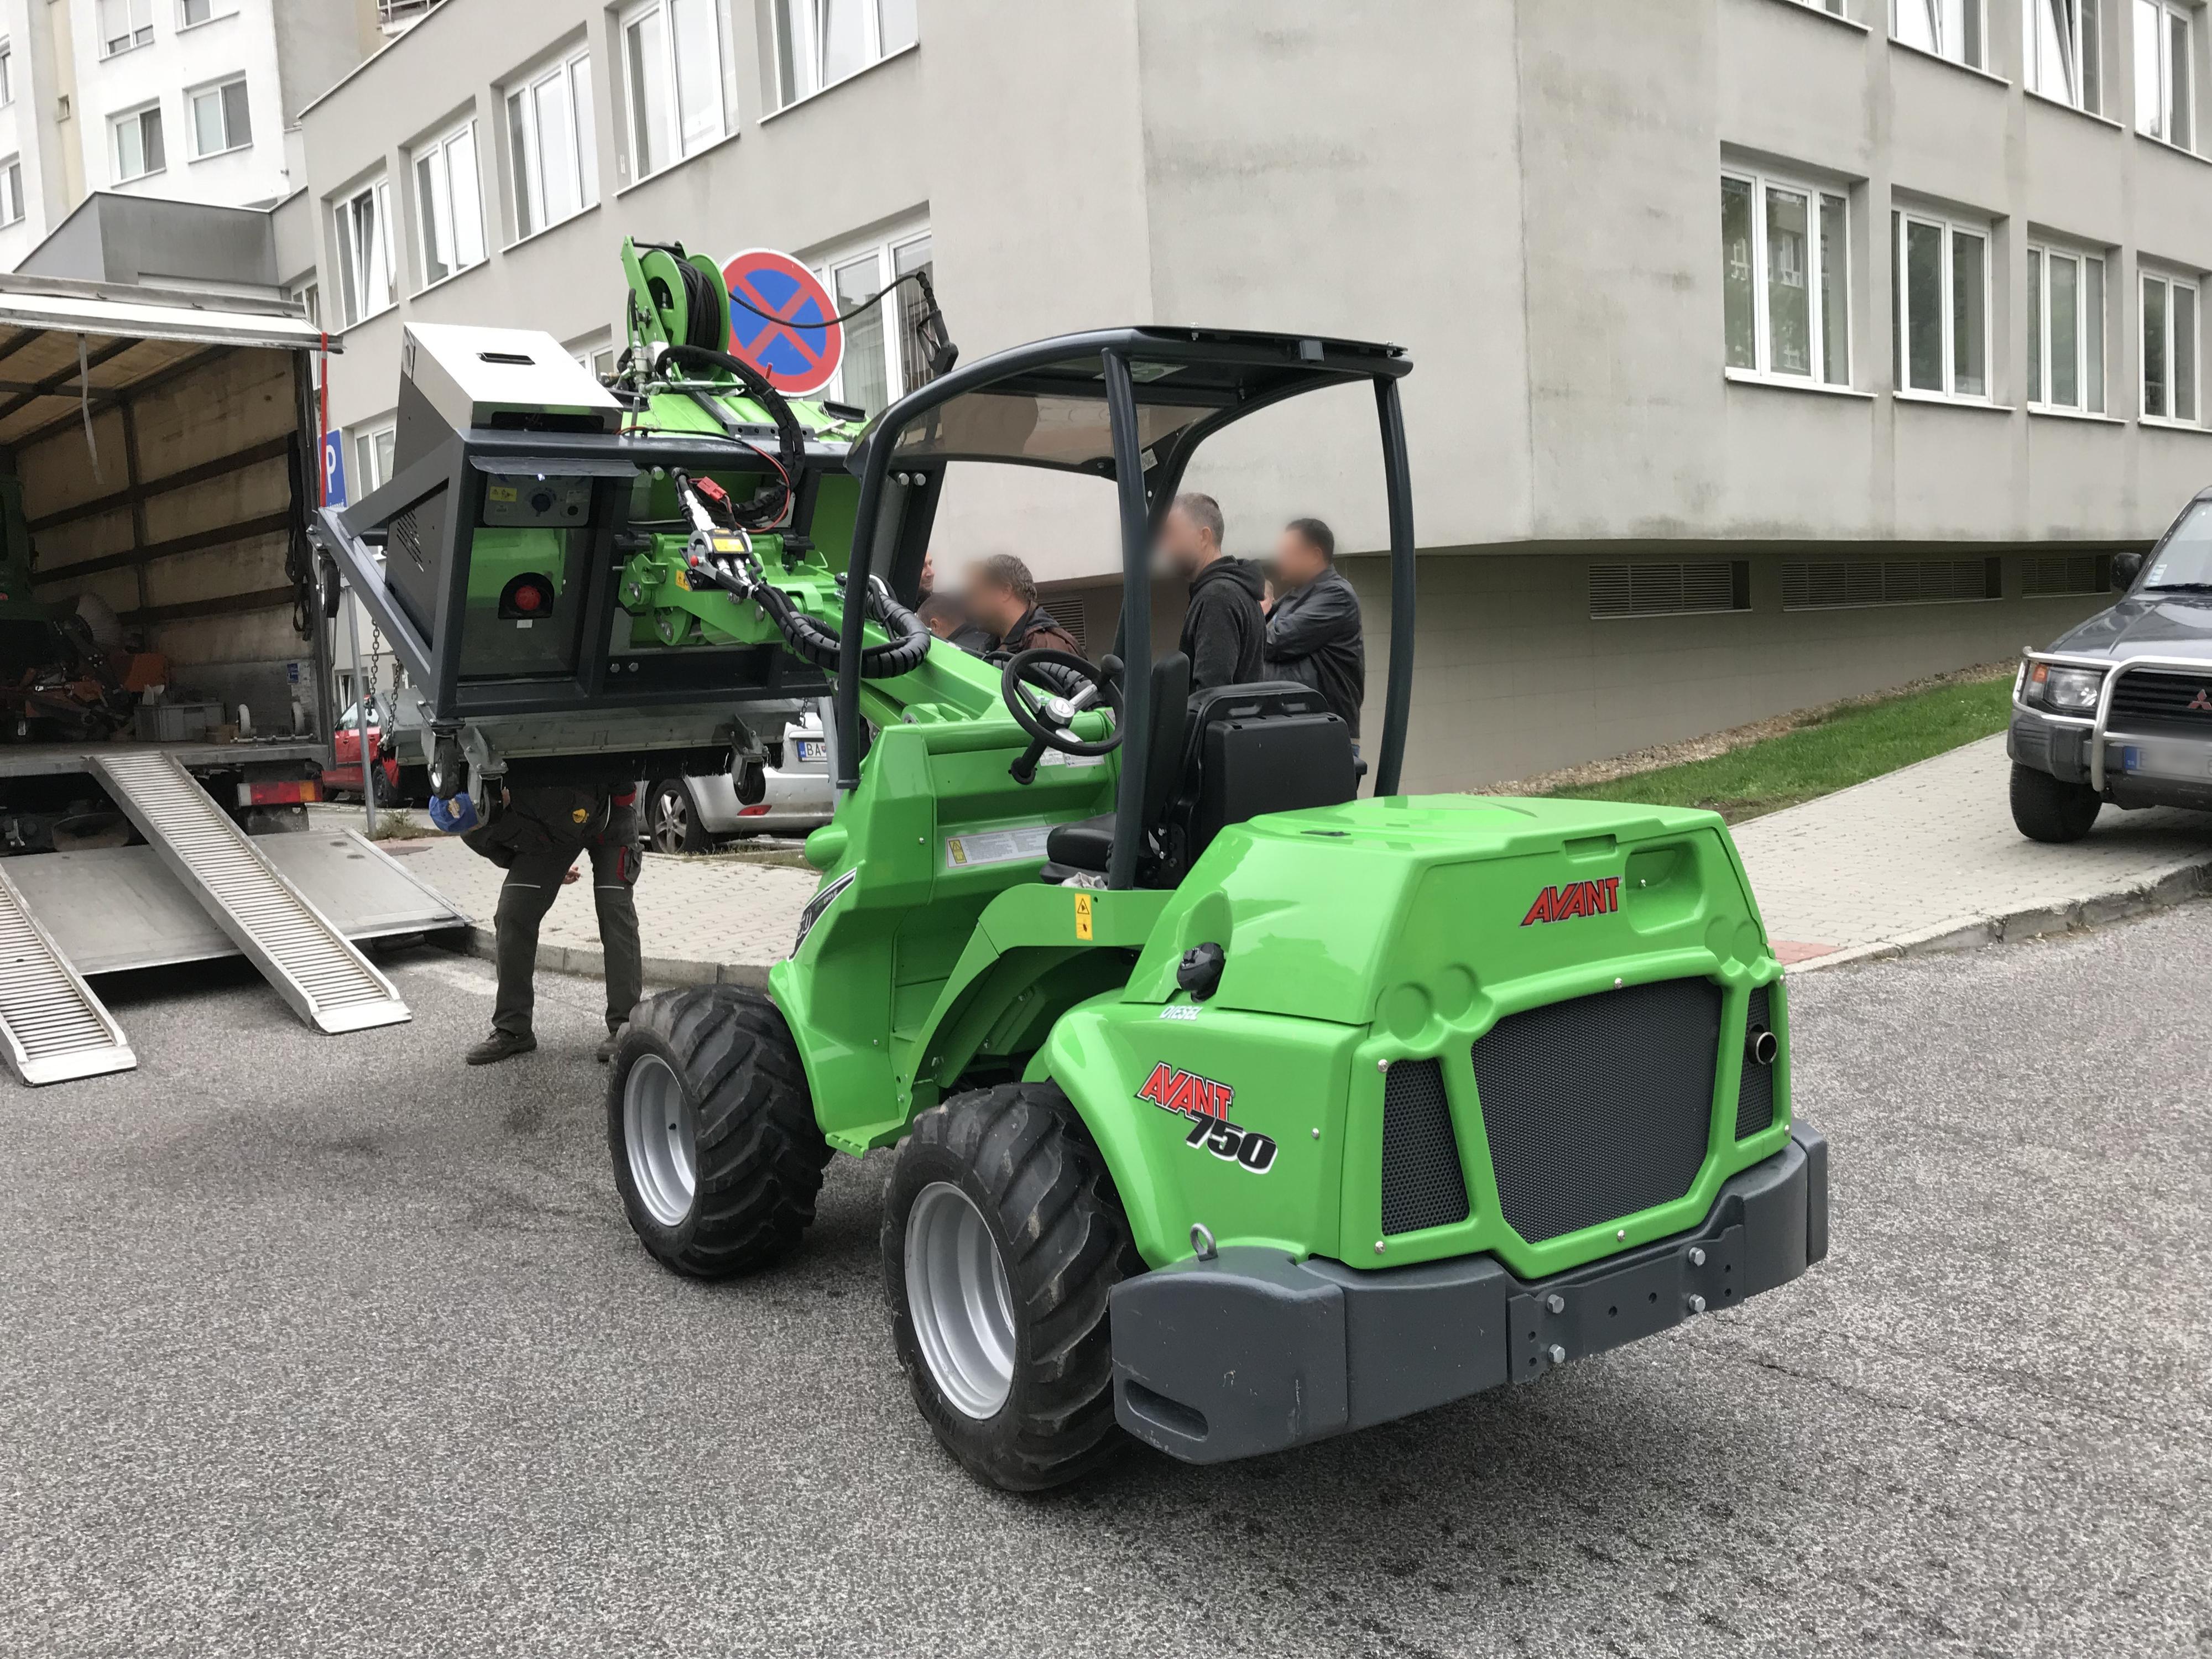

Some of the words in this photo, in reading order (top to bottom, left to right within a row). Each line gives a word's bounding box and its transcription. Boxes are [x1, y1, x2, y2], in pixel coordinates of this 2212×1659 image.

[326, 445, 336, 493] P
[807, 743, 822, 756] BA
[1520, 876, 1620, 927] AVANT
[1159, 1005, 1203, 1020] DIESEL
[1136, 1061, 1234, 1123] AVANT
[1185, 1108, 1279, 1175] 750
